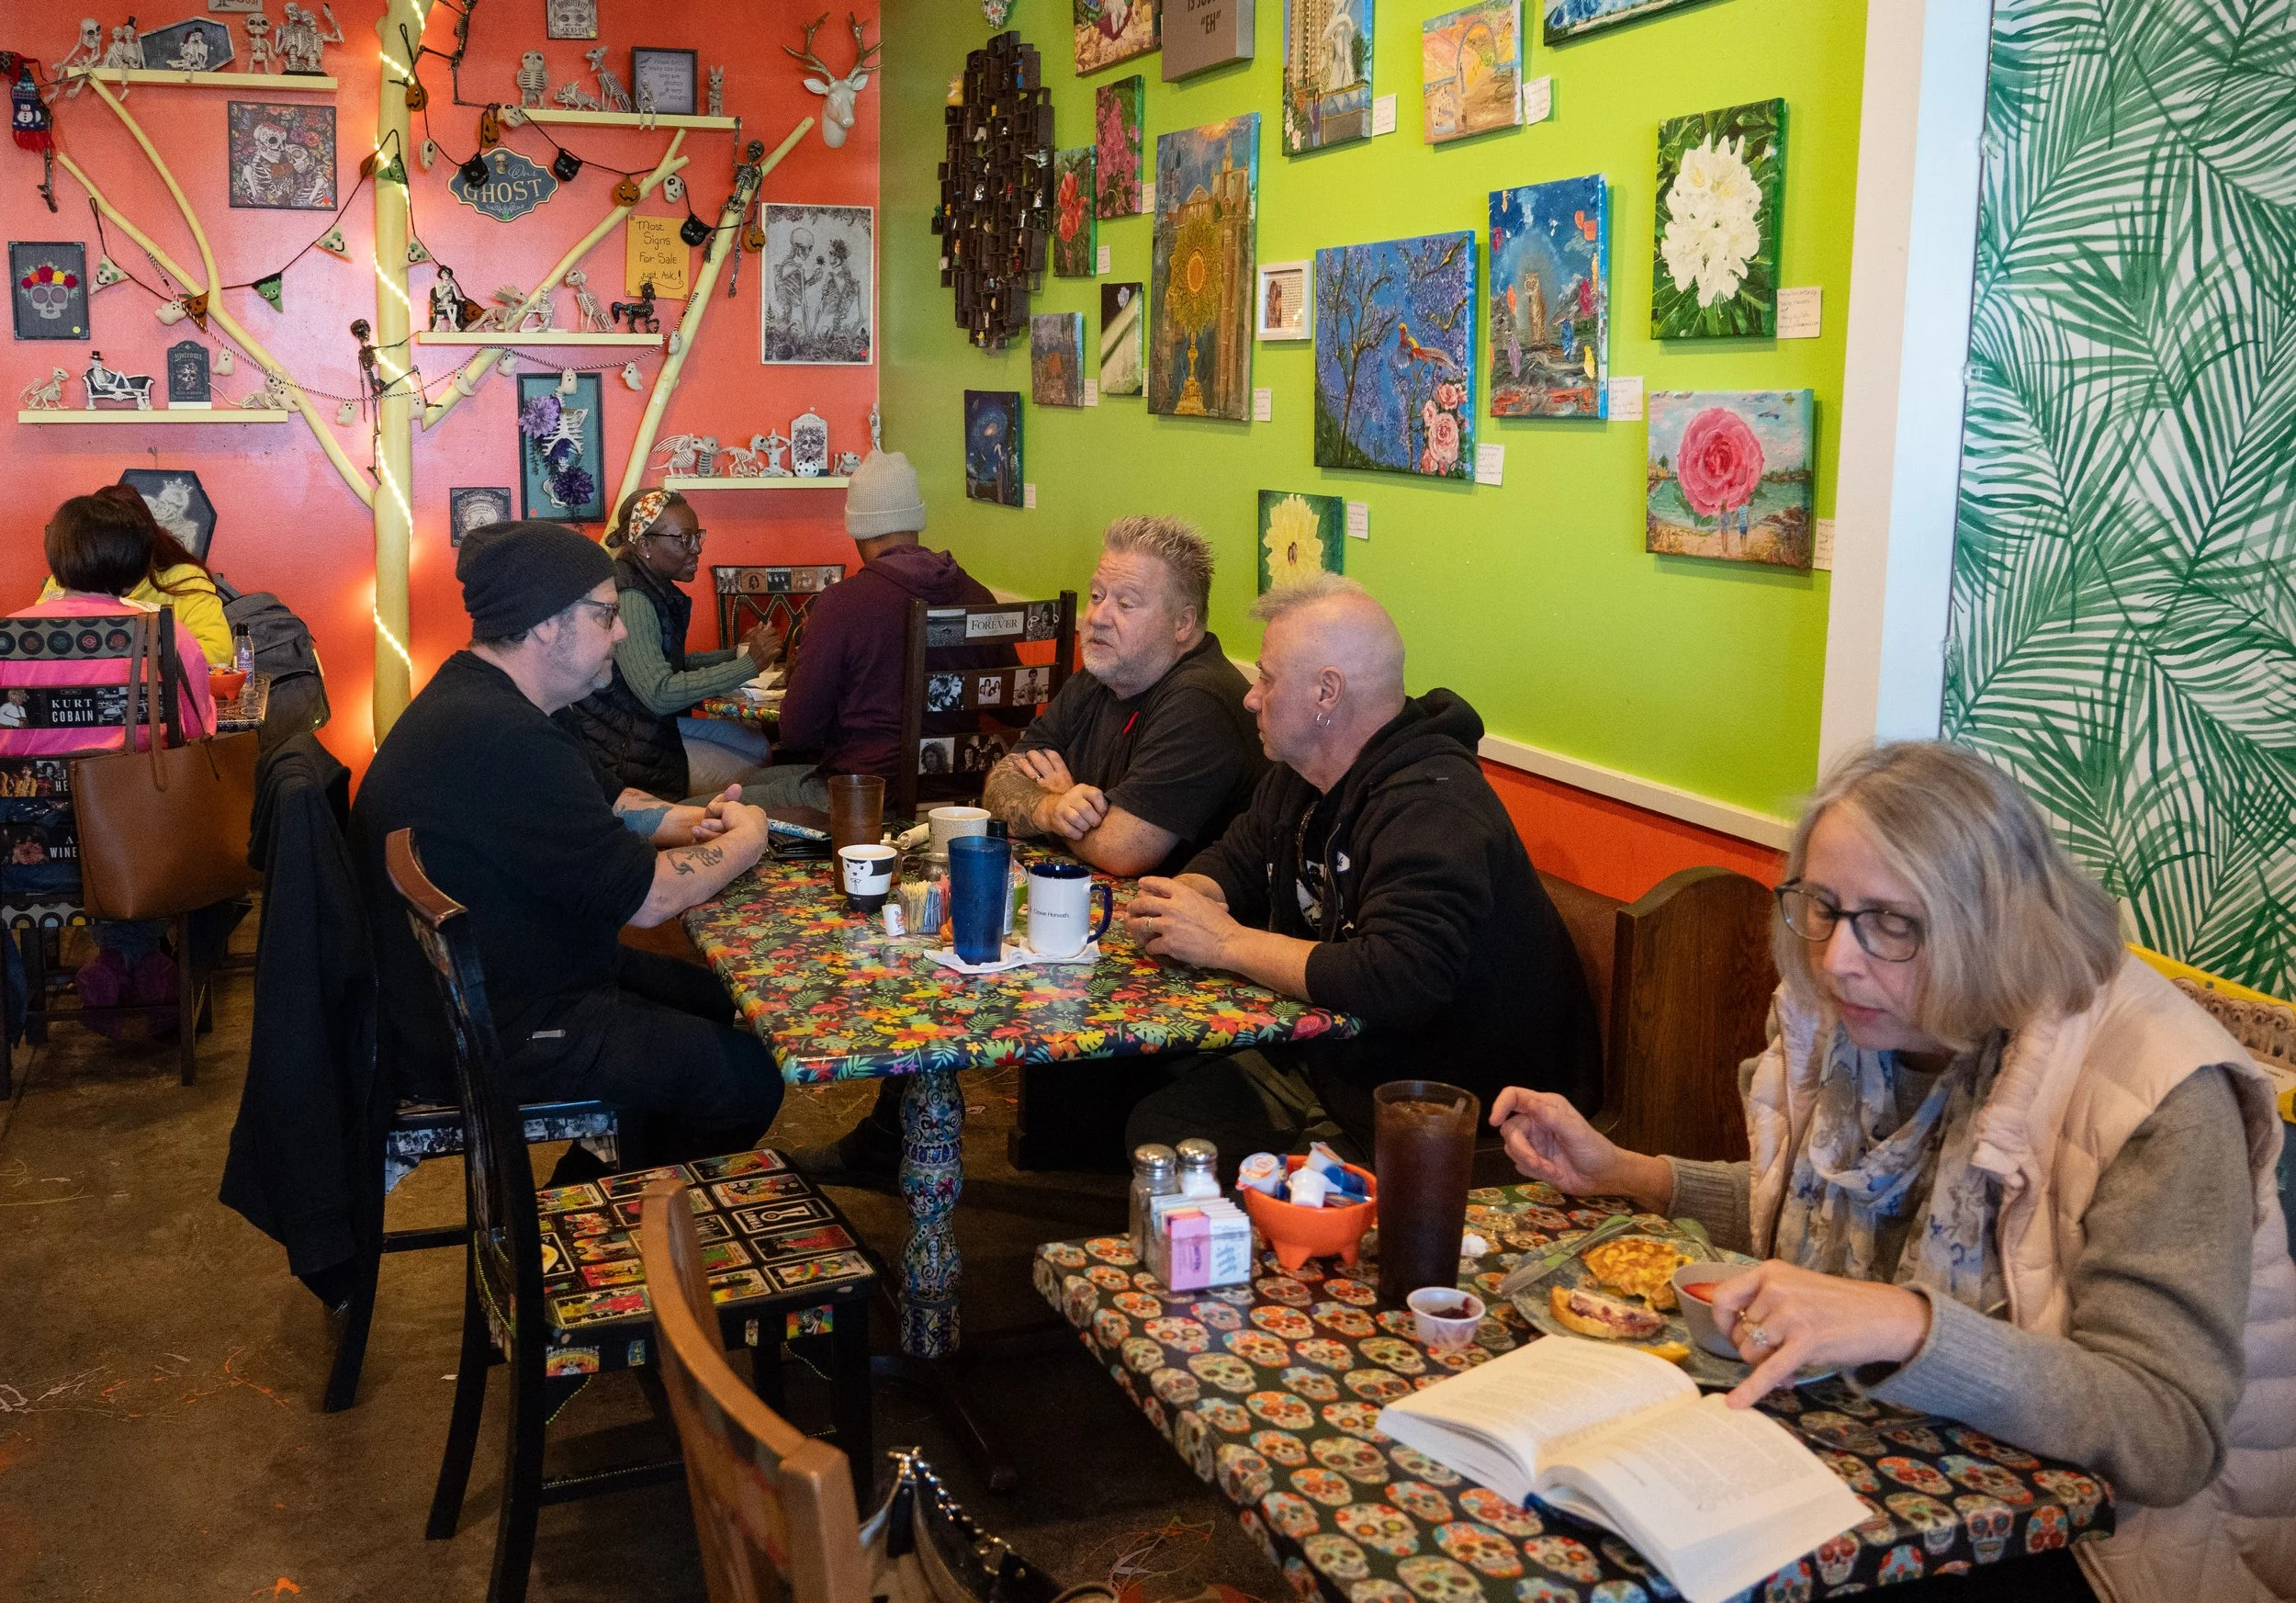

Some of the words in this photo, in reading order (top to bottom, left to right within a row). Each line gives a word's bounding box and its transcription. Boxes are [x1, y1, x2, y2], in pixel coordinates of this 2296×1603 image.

[463, 178, 543, 203] GHOST
[636, 220, 665, 231] Most
[643, 231, 671, 250] Signs
[639, 251, 654, 264] For
[174, 351, 203, 363] Welcome
[971, 618, 1018, 631] FOREVER
[51, 698, 93, 708] KURT
[51, 710, 94, 723] COBAIN
